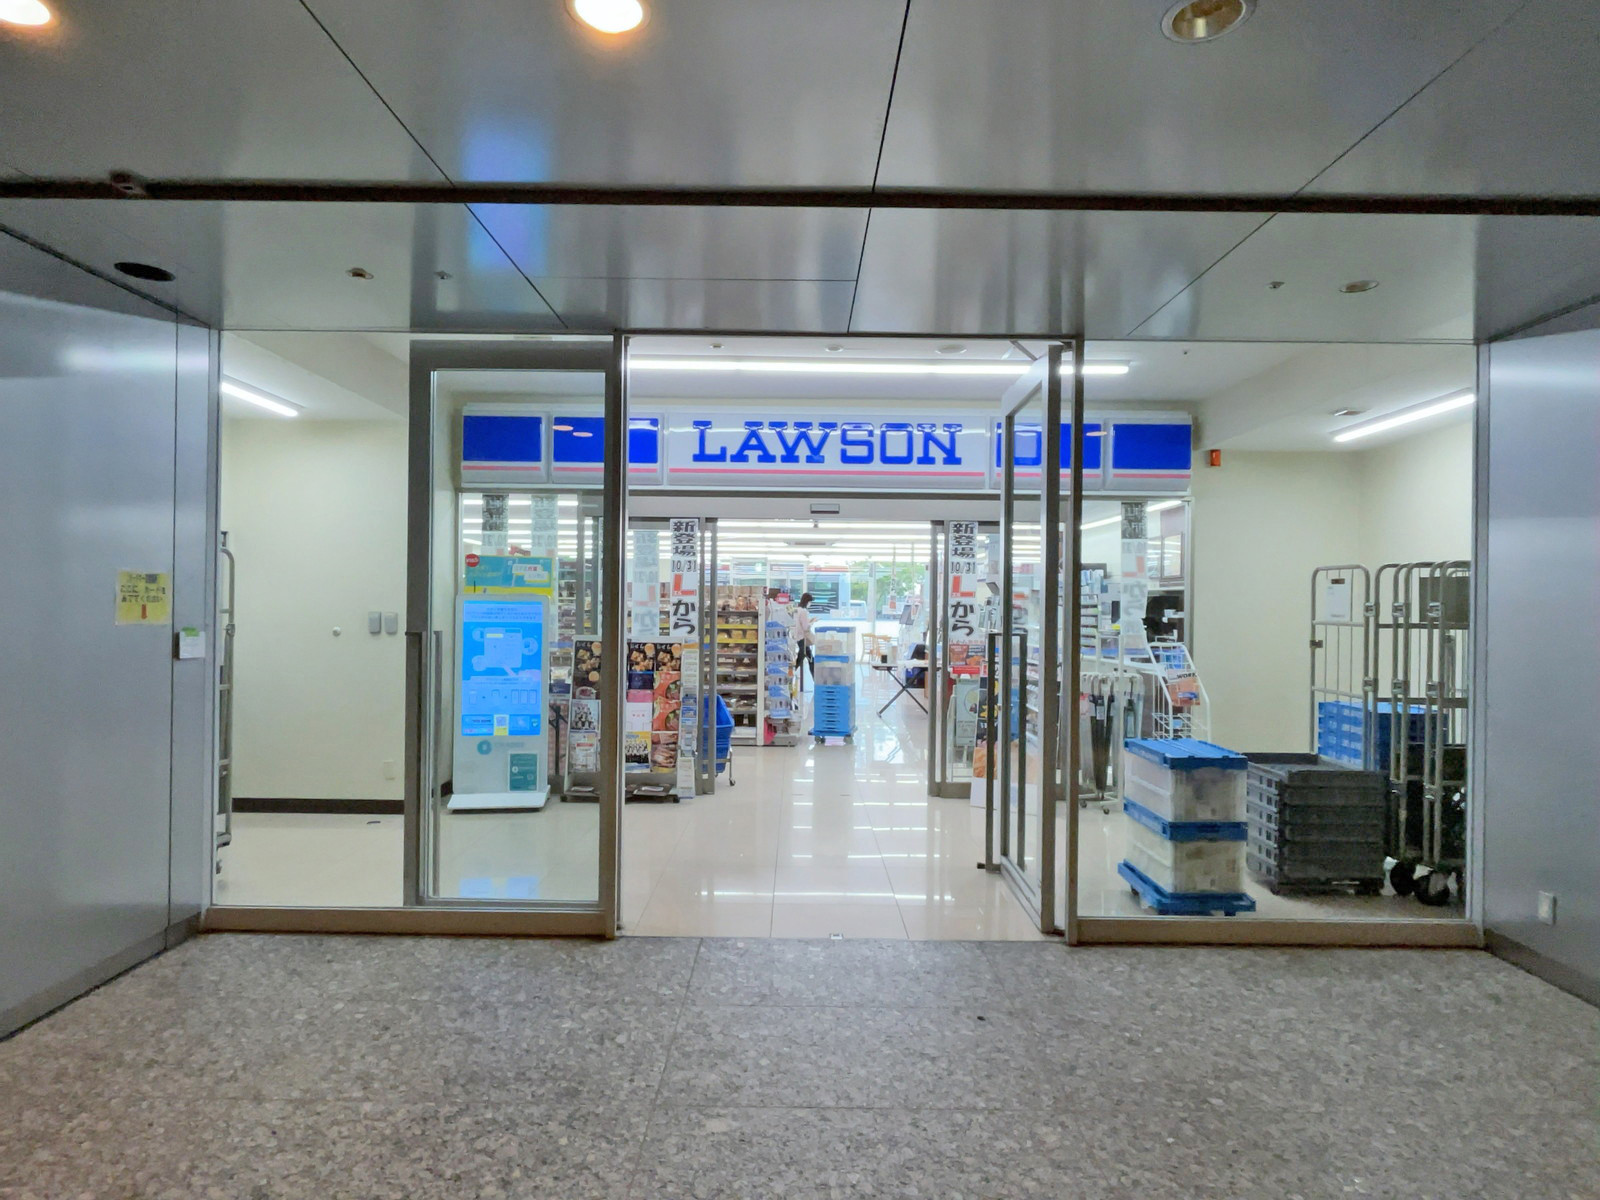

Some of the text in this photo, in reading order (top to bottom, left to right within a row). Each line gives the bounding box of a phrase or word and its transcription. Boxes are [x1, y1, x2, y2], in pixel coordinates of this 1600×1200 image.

[692, 420, 962, 465] LAWSON
[672, 520, 696, 557] 新登場
[951, 522, 975, 558] 新登場
[672, 560, 697, 572] 10/31
[951, 561, 976, 574] 10/31
